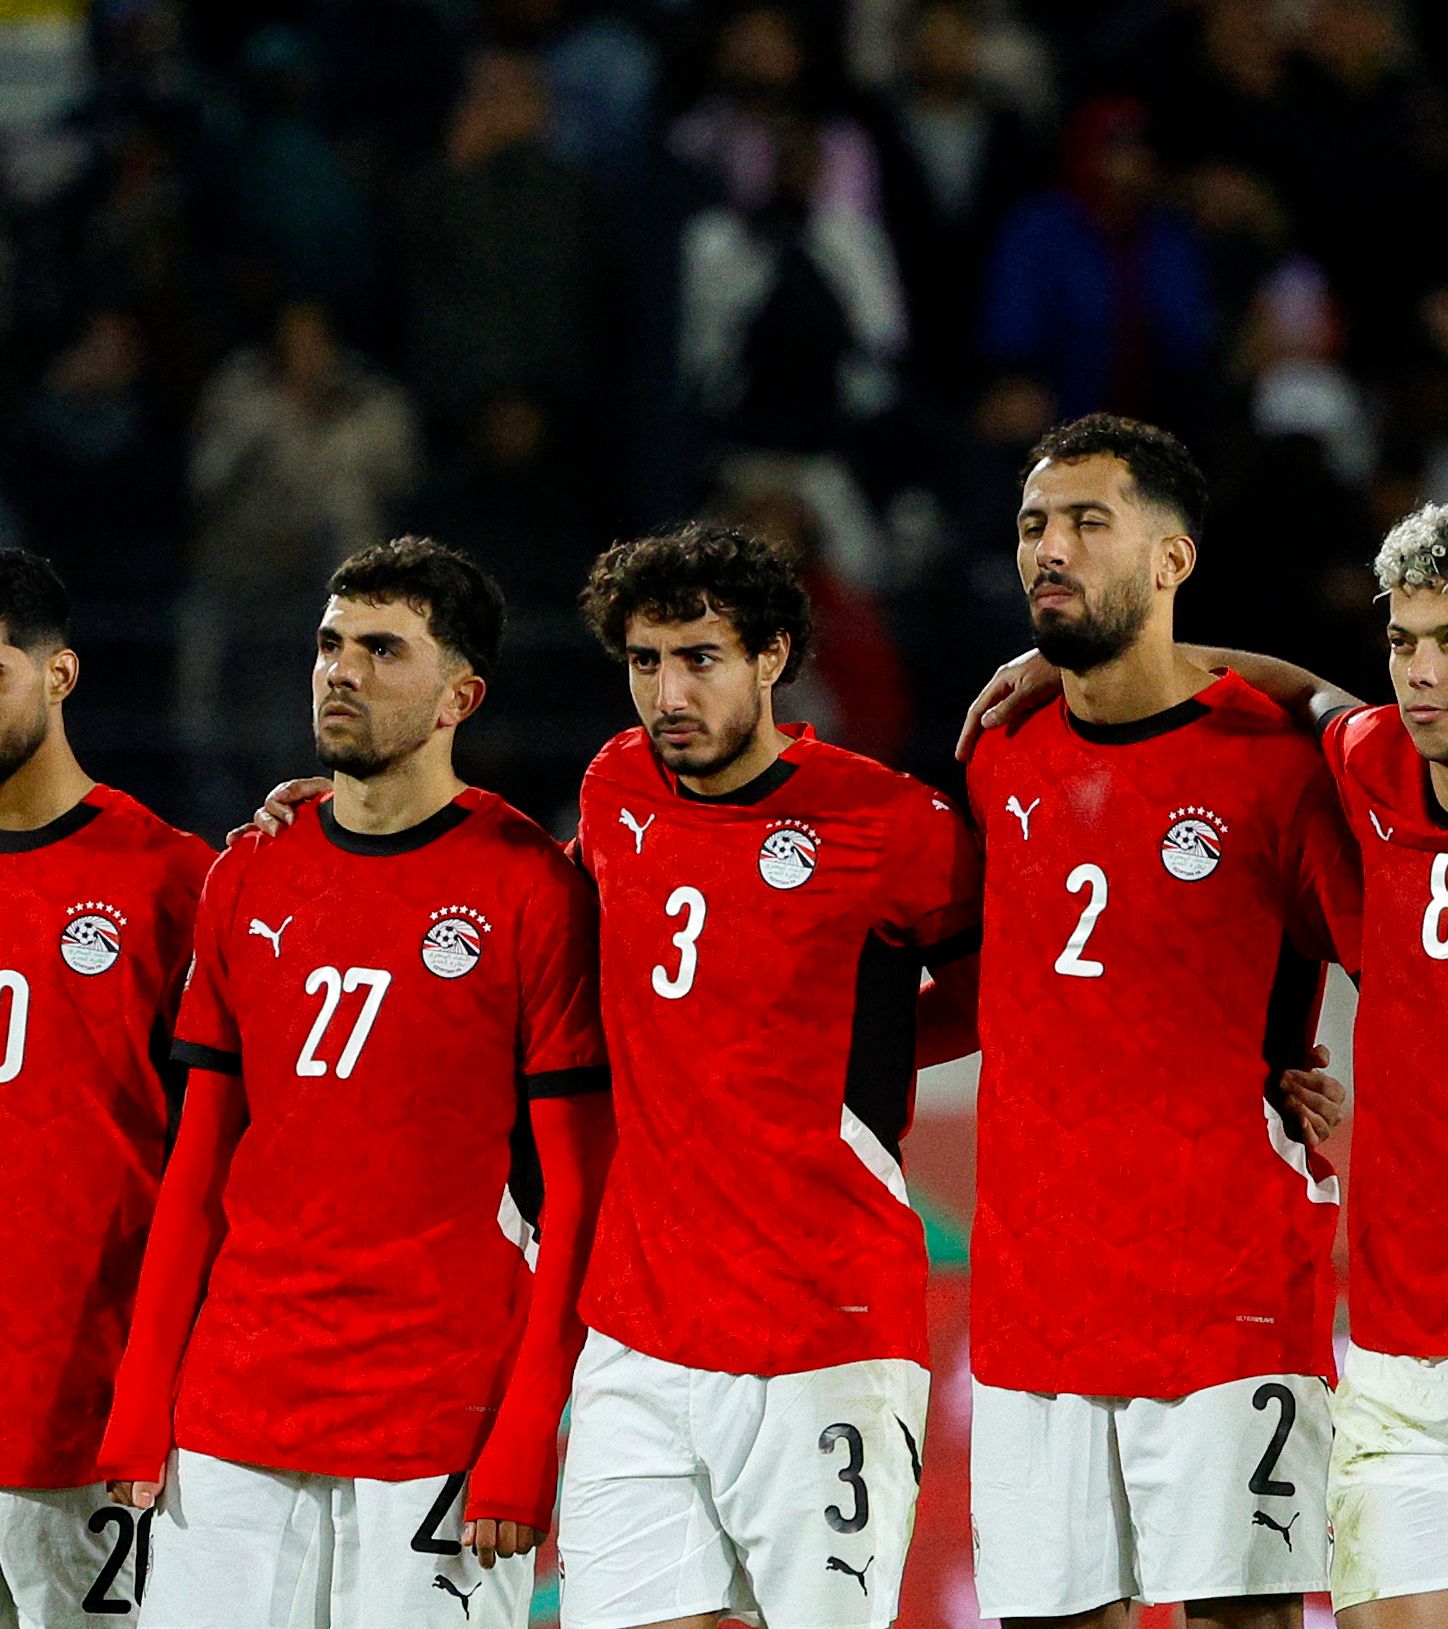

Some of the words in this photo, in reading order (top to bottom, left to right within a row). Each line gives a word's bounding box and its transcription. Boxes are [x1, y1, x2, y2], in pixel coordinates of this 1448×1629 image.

[651, 885, 707, 1000] 3
[1054, 863, 1108, 978] 2
[296, 965, 392, 1080] 27
[818, 1422, 869, 1534] 3
[1248, 1382, 1297, 1498] 2
[411, 1470, 462, 1556] 2
